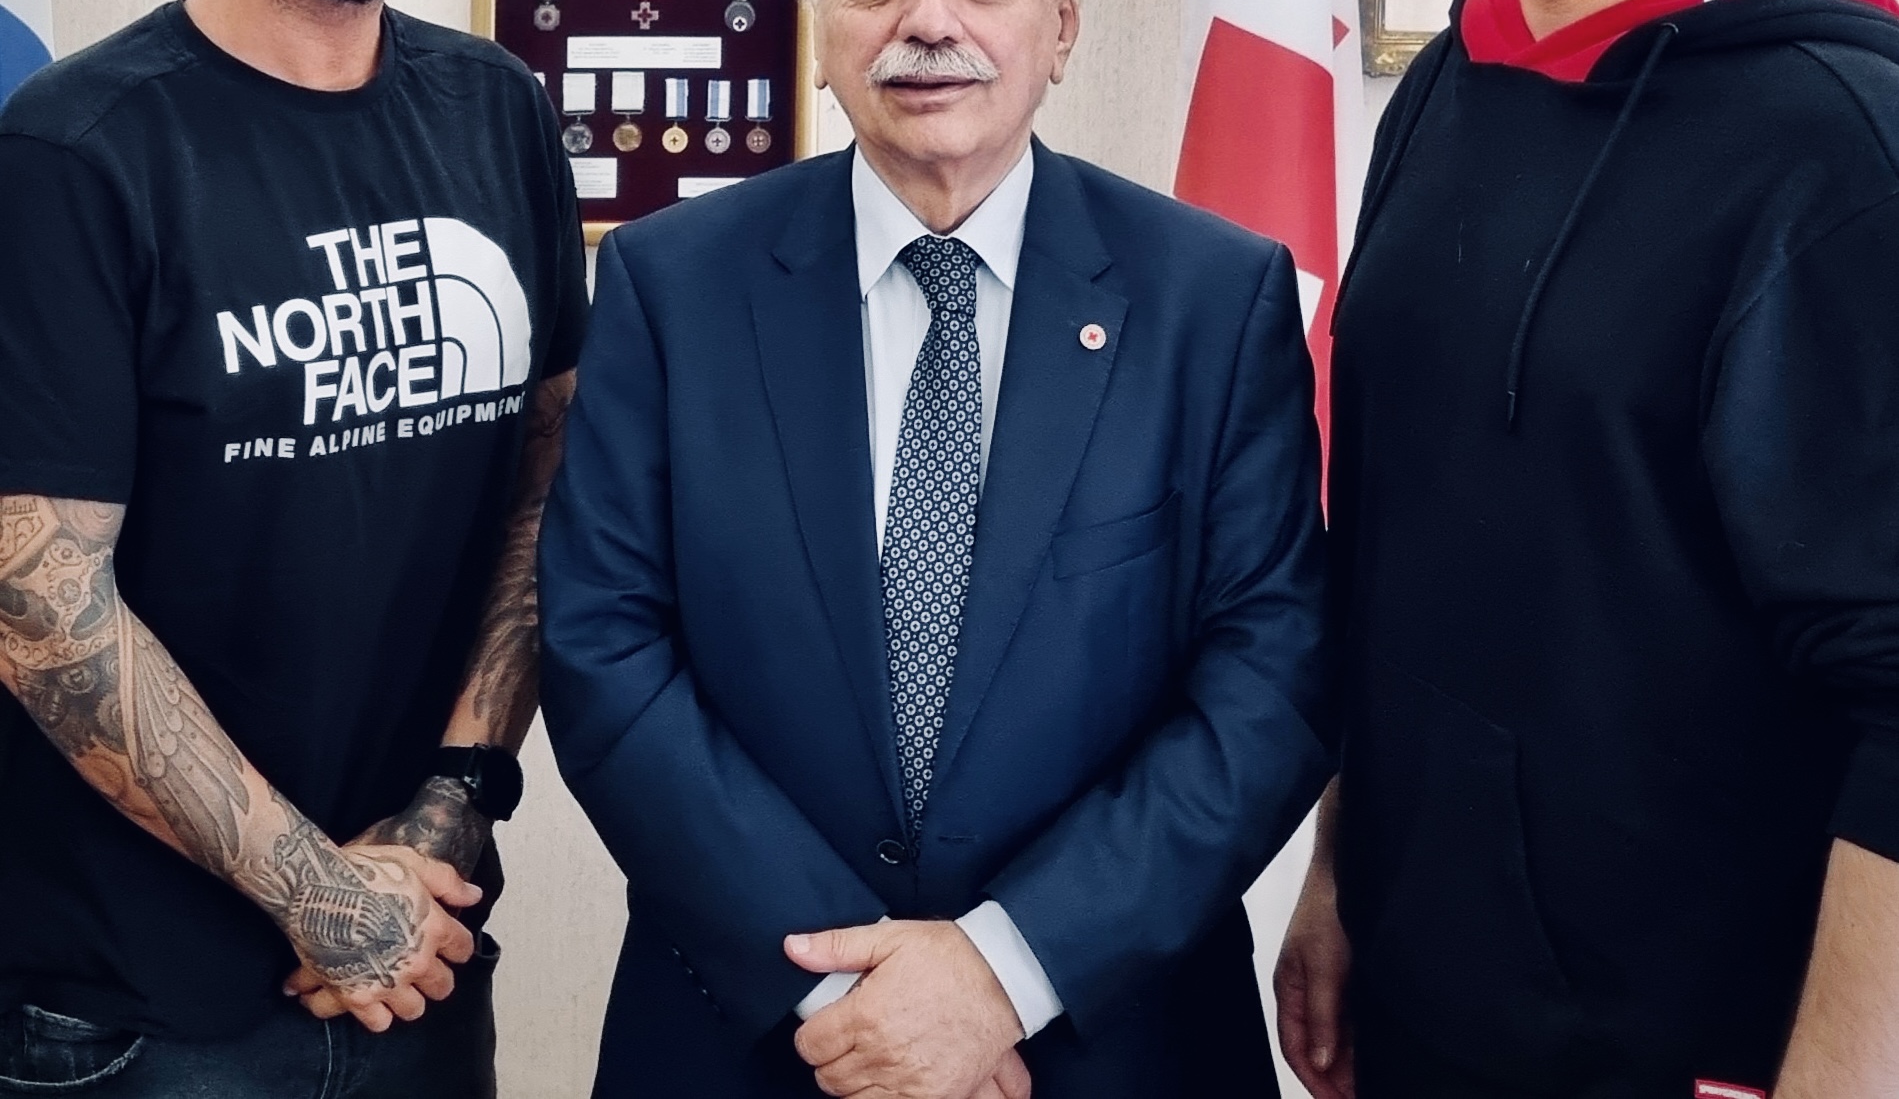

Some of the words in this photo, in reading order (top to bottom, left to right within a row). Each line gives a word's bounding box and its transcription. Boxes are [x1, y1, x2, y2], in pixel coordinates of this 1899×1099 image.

[305, 218, 428, 291] THE
[216, 280, 436, 374] NORTH
[303, 343, 439, 426] FACE
[224, 437, 296, 463] FINE
[309, 421, 386, 457] ALPINE
